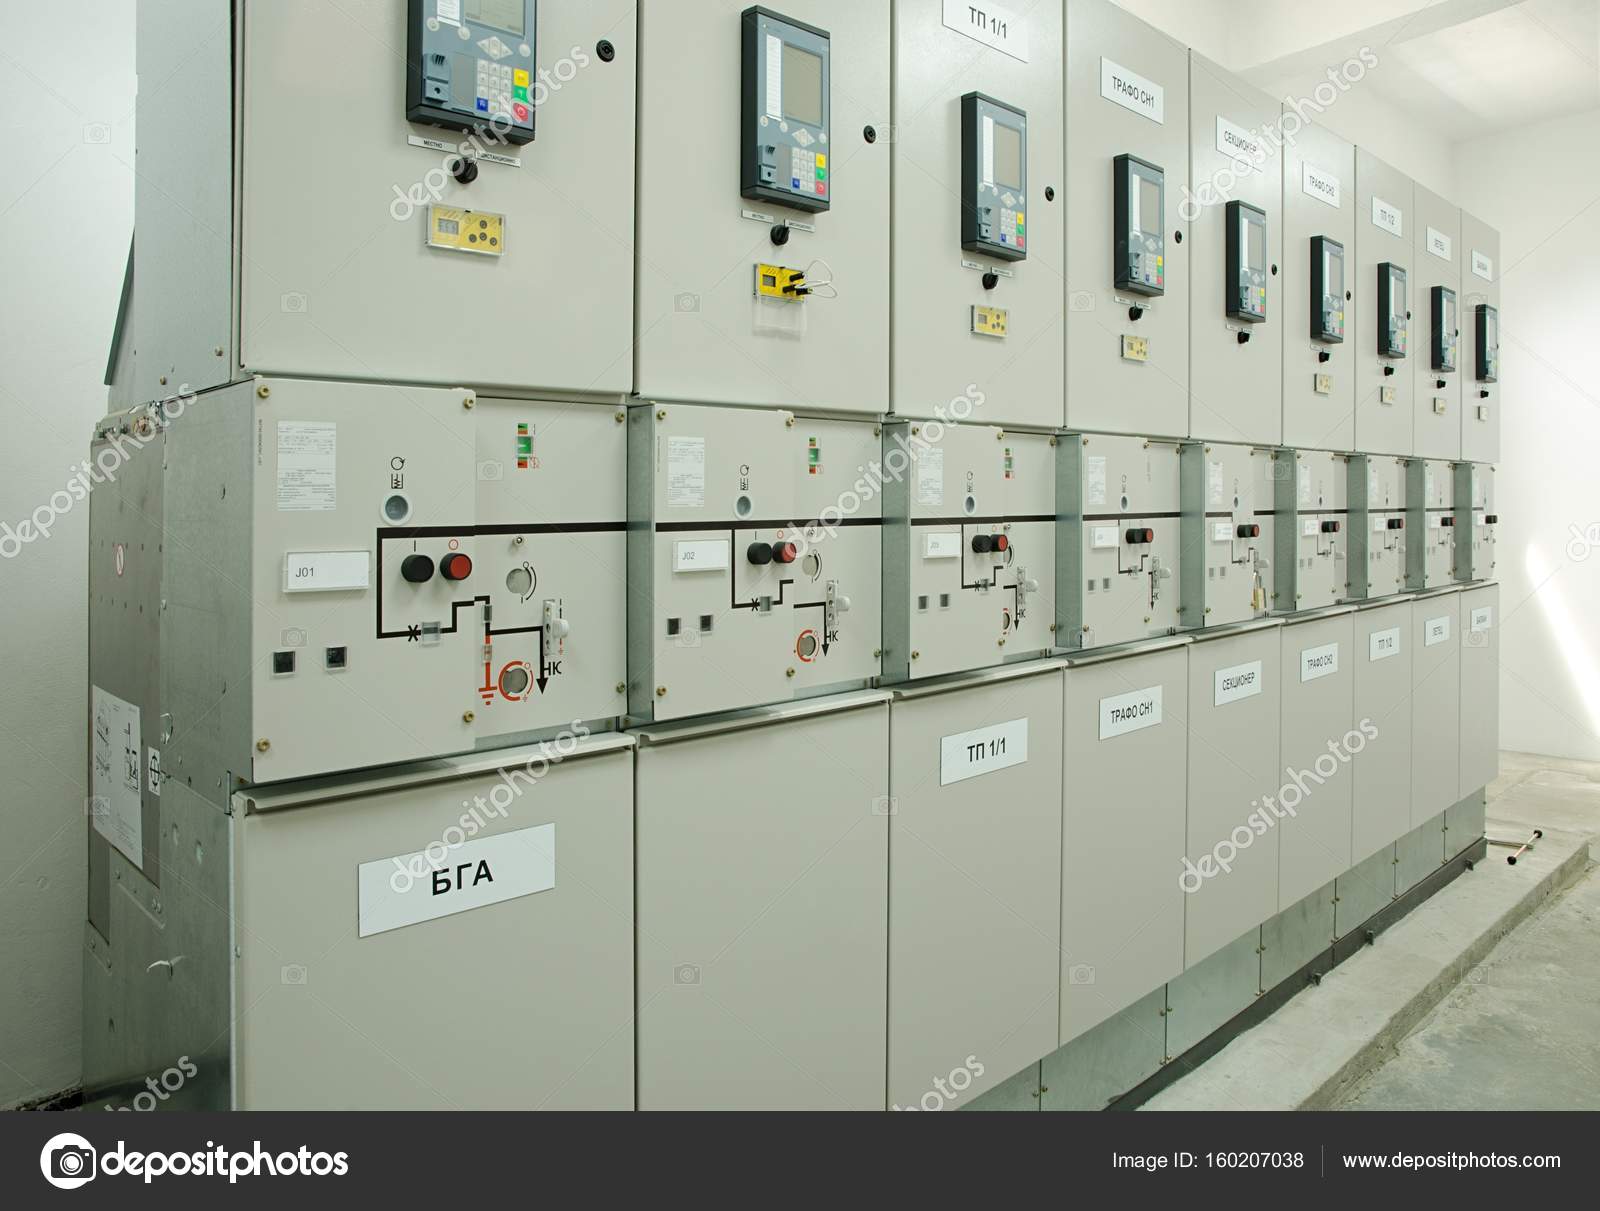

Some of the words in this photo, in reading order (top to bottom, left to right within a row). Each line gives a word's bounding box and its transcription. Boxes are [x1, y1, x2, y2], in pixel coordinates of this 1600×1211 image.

[968, 6, 986, 30] ТП
[990, 17, 1007, 39] 1/1
[1112, 75, 1139, 100] ТРАФО
[1140, 90, 1154, 108] СН1
[423, 139, 443, 149] МЕСТНО
[682, 551, 696, 561] J02
[295, 567, 314, 578] J01
[1222, 671, 1255, 691] СЕКЦИОНЕР
[1110, 704, 1138, 724] ТРАФО
[1139, 700, 1153, 717] СН1
[967, 742, 985, 763] ТП
[989, 736, 1006, 757] 1/1
[432, 859, 494, 896] БГА
